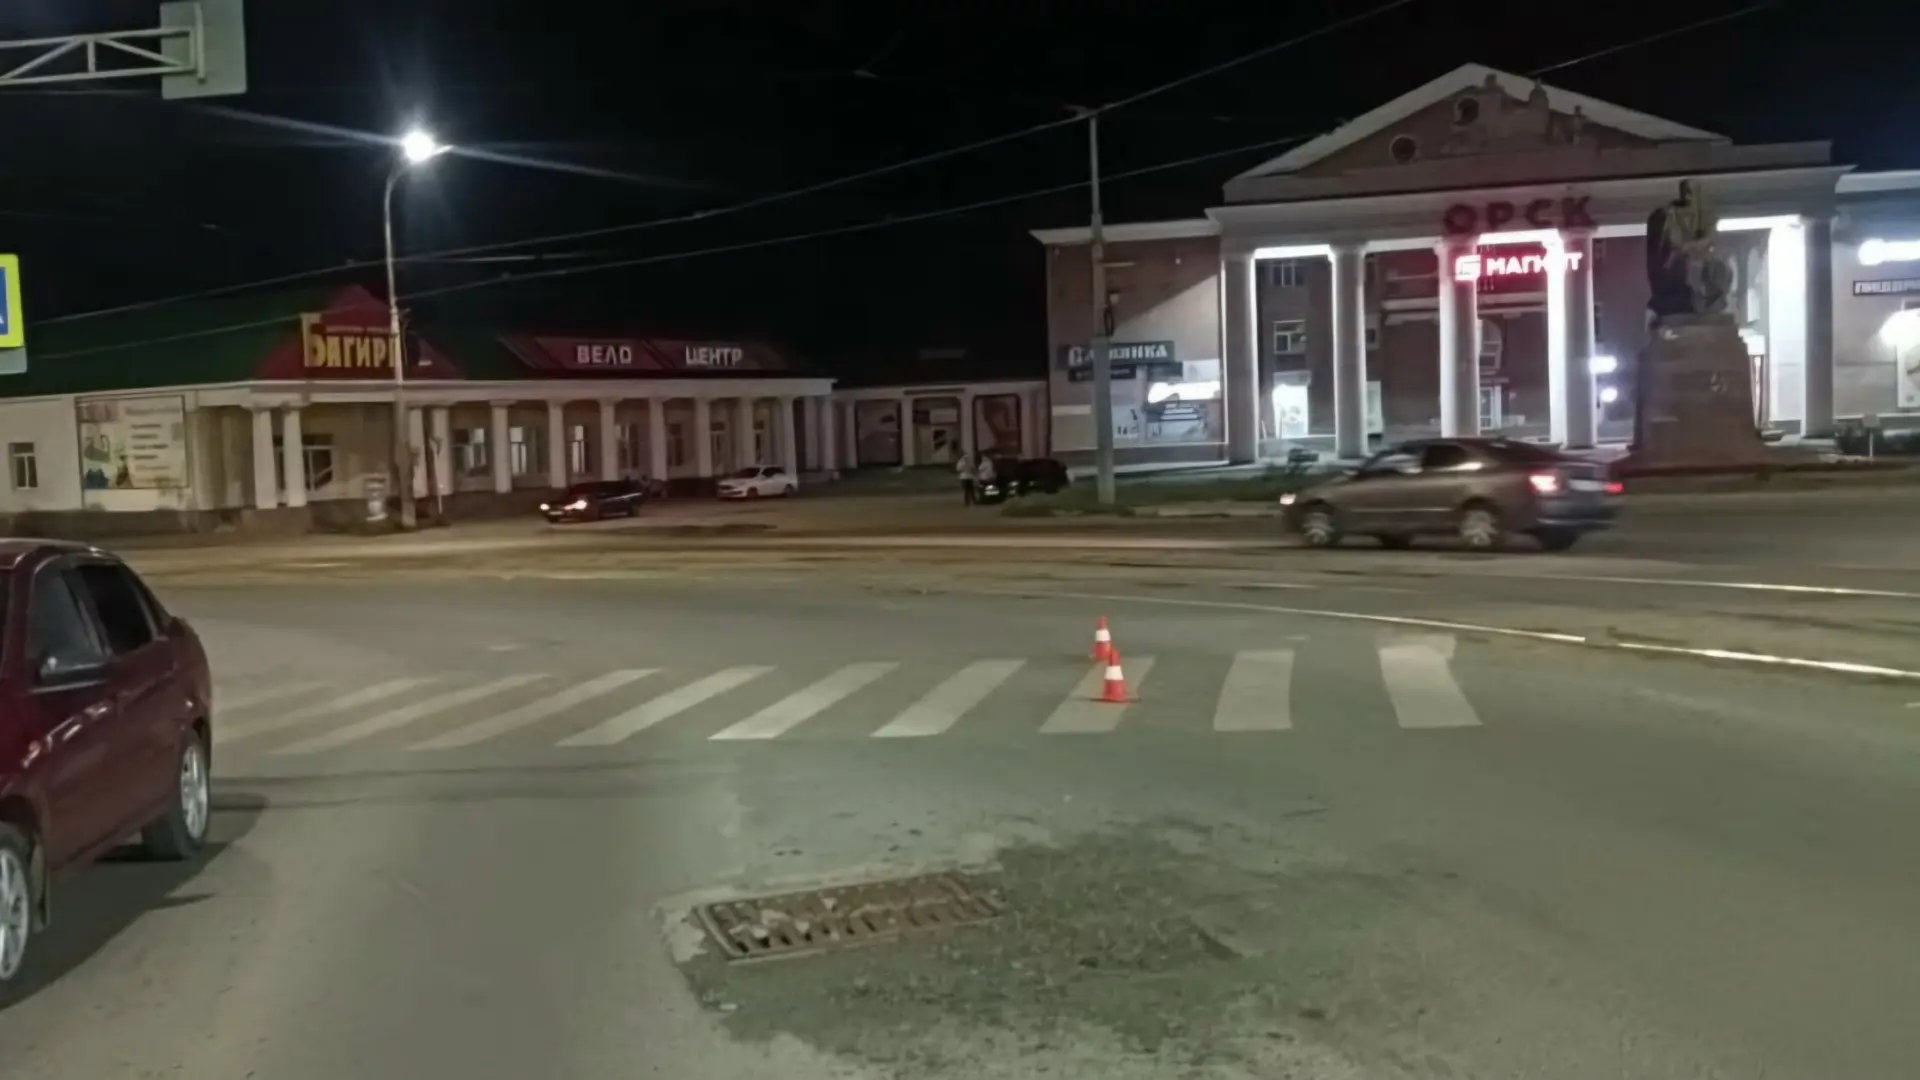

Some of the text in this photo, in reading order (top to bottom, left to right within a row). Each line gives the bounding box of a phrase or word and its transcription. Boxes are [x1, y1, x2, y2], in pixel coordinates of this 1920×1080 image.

[1443, 196, 1595, 234] ОРСК
[1486, 252, 1583, 276] МАГНТ
[577, 345, 743, 366] ВЕЛО ЦЕНТР
